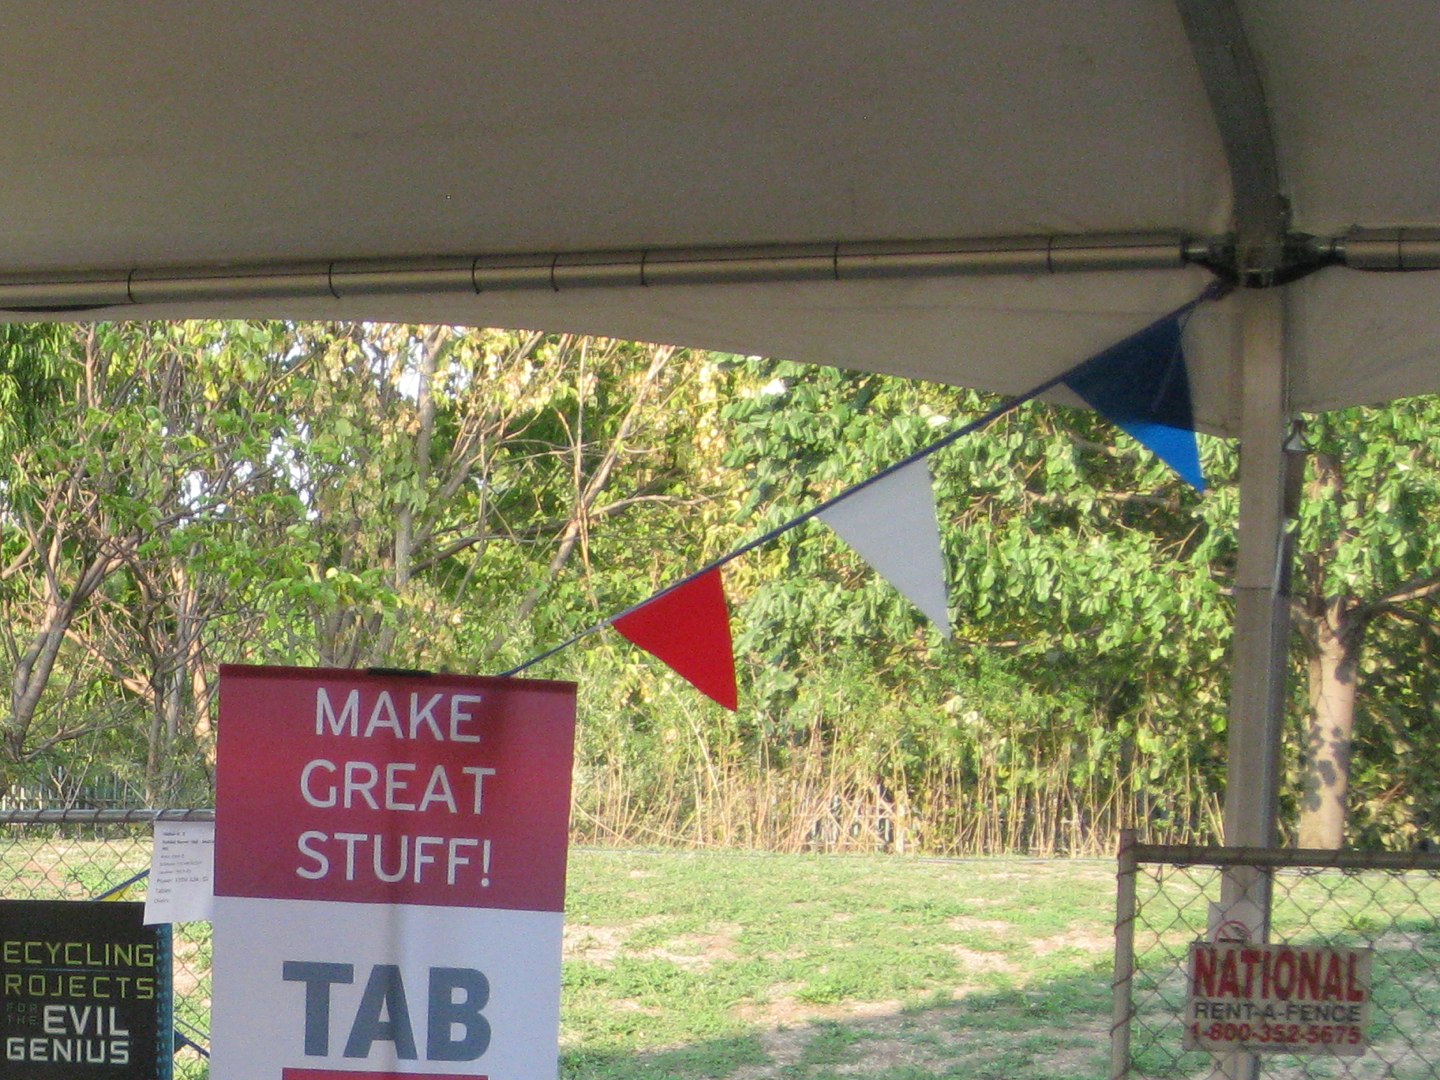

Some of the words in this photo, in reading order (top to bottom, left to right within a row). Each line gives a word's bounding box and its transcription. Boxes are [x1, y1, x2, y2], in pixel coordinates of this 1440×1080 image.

[315, 687, 482, 743] MAKE
[299, 758, 496, 815] GREAT
[296, 830, 492, 888] STUFF!
[1193, 949, 1364, 1002] NATIONAL
[43, 1004, 129, 1037] EVIL
[282, 960, 492, 1062] TAB
[1191, 1022, 1361, 1044] 1-800-352-5675
[1195, 1002, 1361, 1022] RENT-A-FENCE
[6, 1037, 129, 1064] GENIUS
